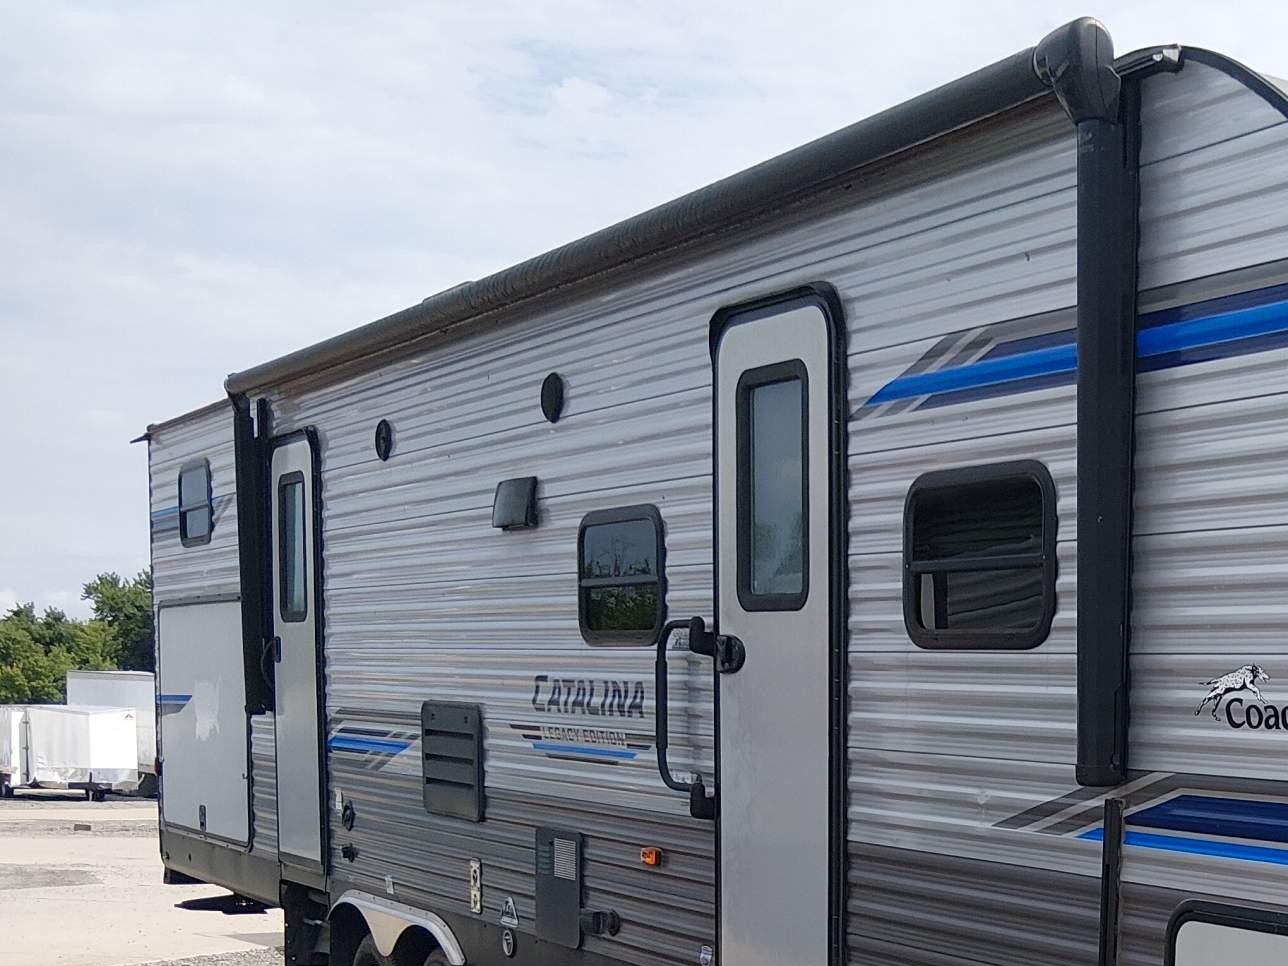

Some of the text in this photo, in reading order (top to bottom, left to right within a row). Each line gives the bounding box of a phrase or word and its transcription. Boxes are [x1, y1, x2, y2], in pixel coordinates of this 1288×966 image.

[531, 675, 645, 718] CATALINA
[542, 725, 627, 747] LEGACY EDITION
